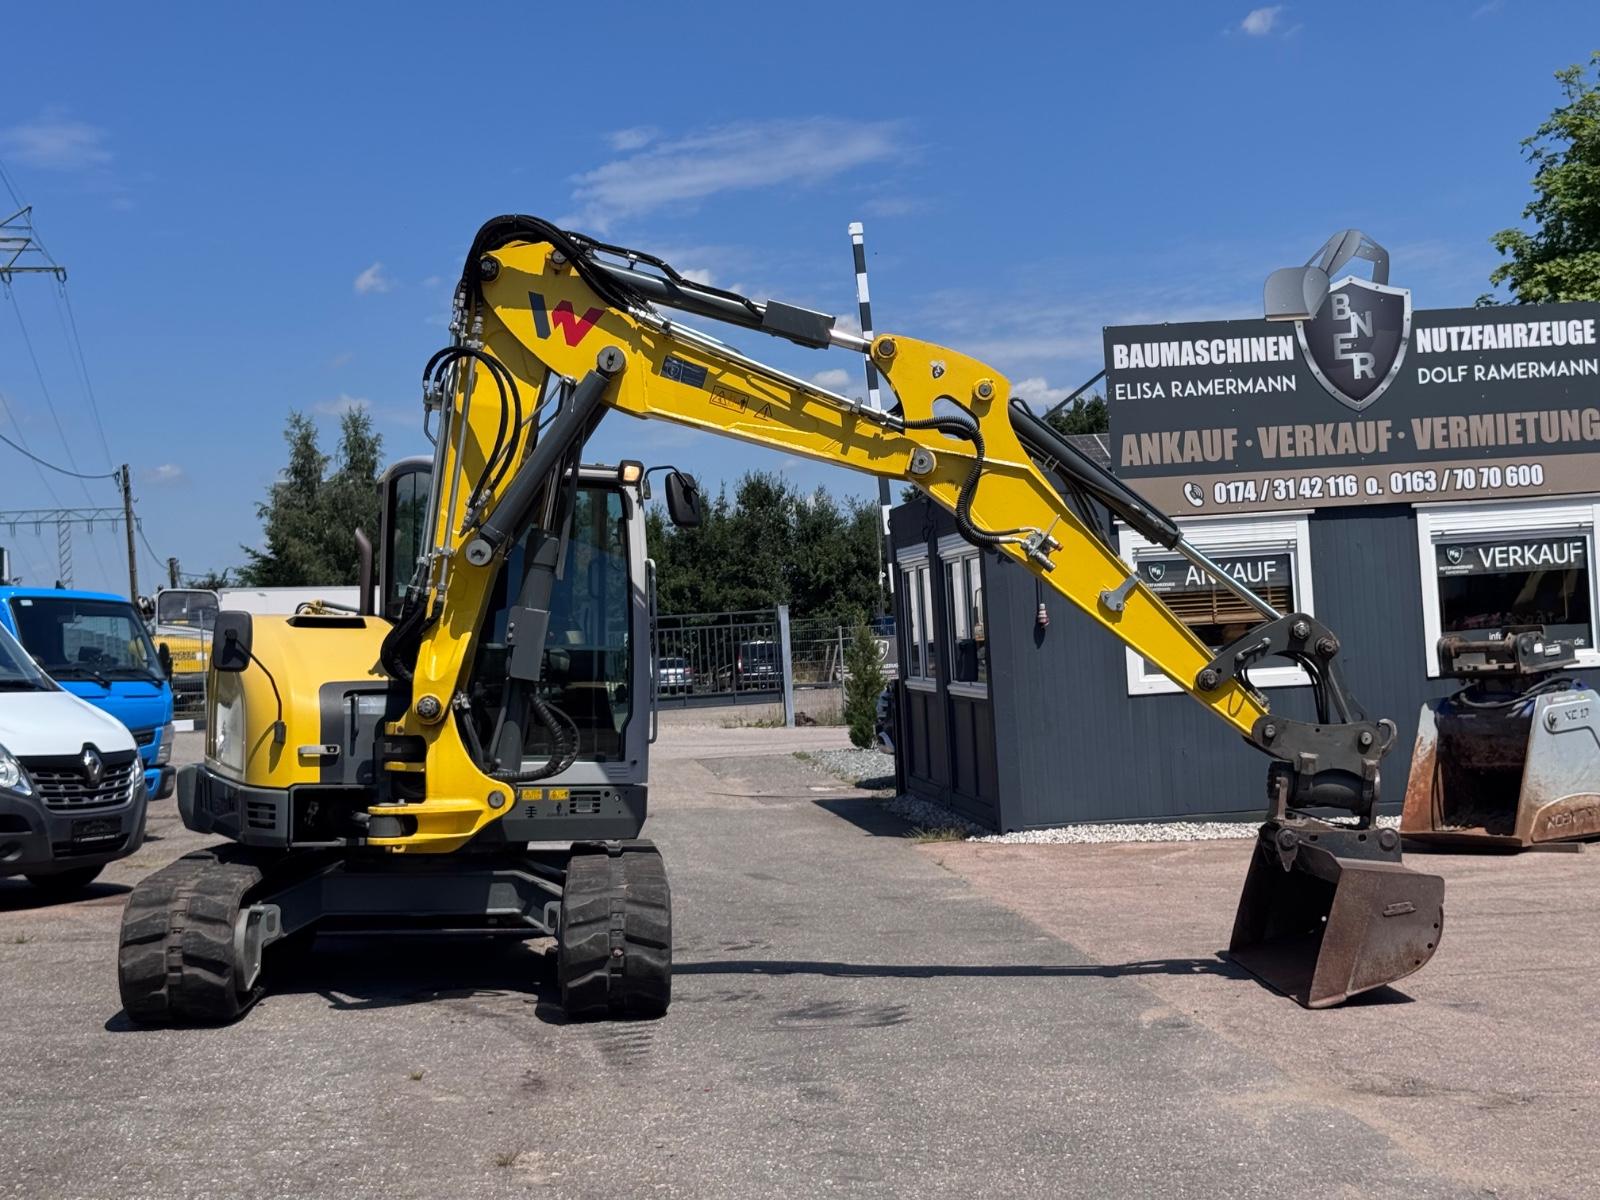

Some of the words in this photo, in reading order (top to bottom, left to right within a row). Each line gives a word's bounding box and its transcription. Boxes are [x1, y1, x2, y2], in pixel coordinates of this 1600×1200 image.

[1416, 319, 1596, 353] NUTZFAHRZEUGE
[1113, 335, 1294, 369] BAUMASCHINEN
[1418, 365, 1468, 384] DOLF
[1474, 358, 1599, 382] RAMERMANN
[1115, 381, 1166, 400] ELISA
[1171, 375, 1297, 398] RAMERMANN
[1121, 428, 1238, 466] ANKAUF
[1256, 420, 1392, 459] VERKAUF
[1411, 407, 1600, 450] VERMIETUNG
[1213, 480, 1257, 504] 0174
[1389, 469, 1437, 494] 0163
[1505, 463, 1544, 487] 600
[1478, 542, 1583, 567] VERKAUF
[1185, 561, 1276, 586] ANAUF
